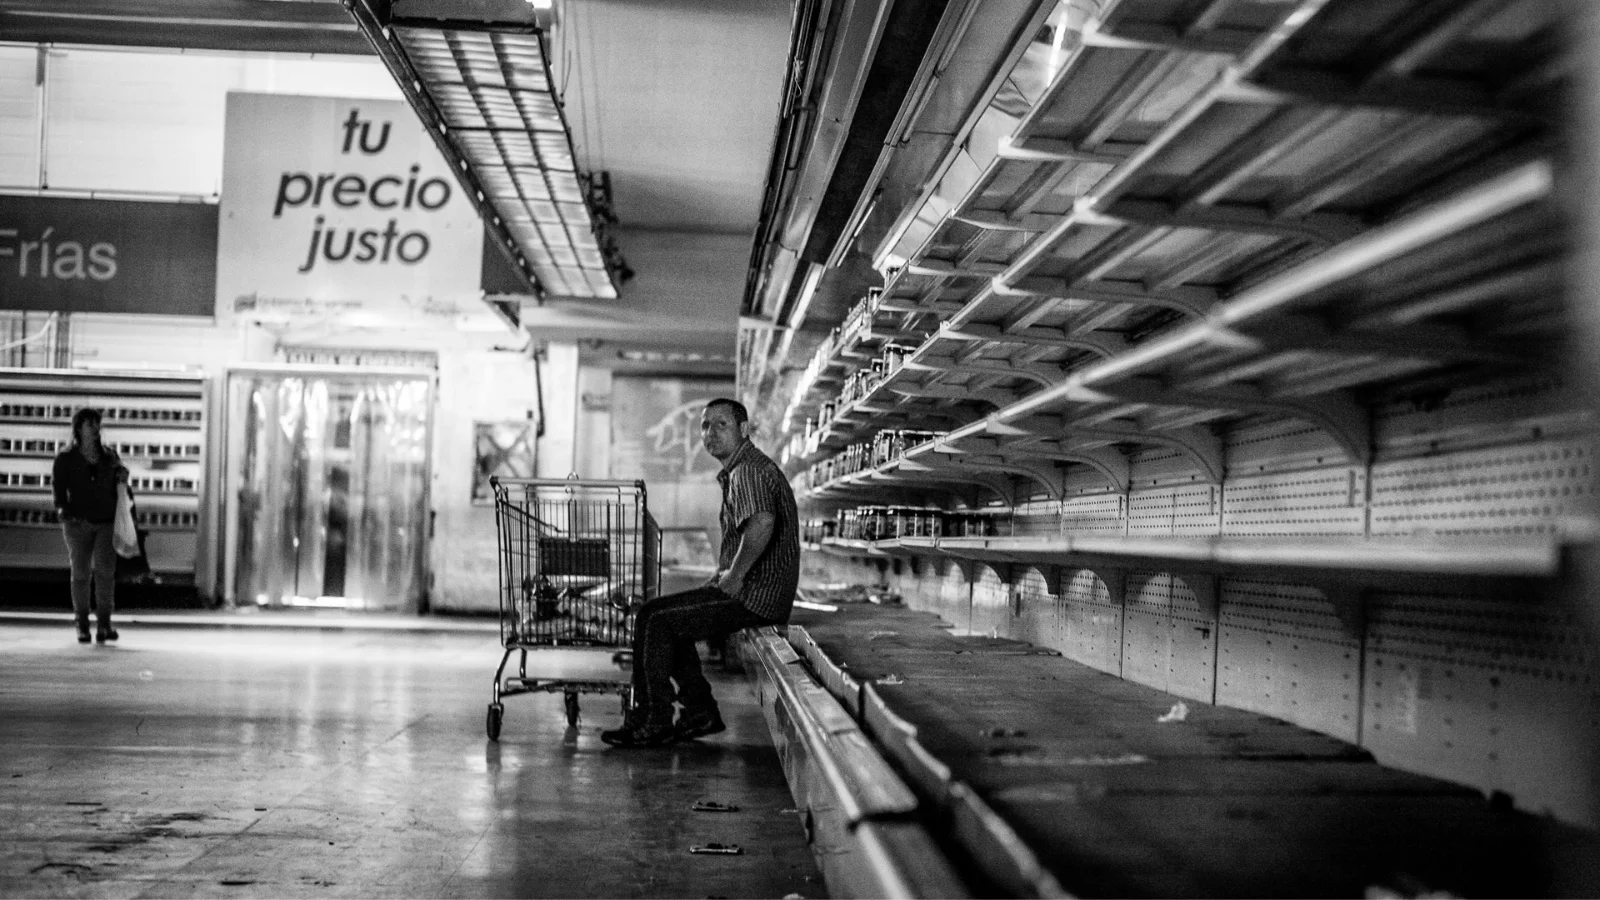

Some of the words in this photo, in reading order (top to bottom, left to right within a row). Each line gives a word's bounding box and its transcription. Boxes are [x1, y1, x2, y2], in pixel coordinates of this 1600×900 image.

[342, 108, 391, 154] tu
[273, 165, 451, 217] precio
[298, 216, 430, 274] justo
